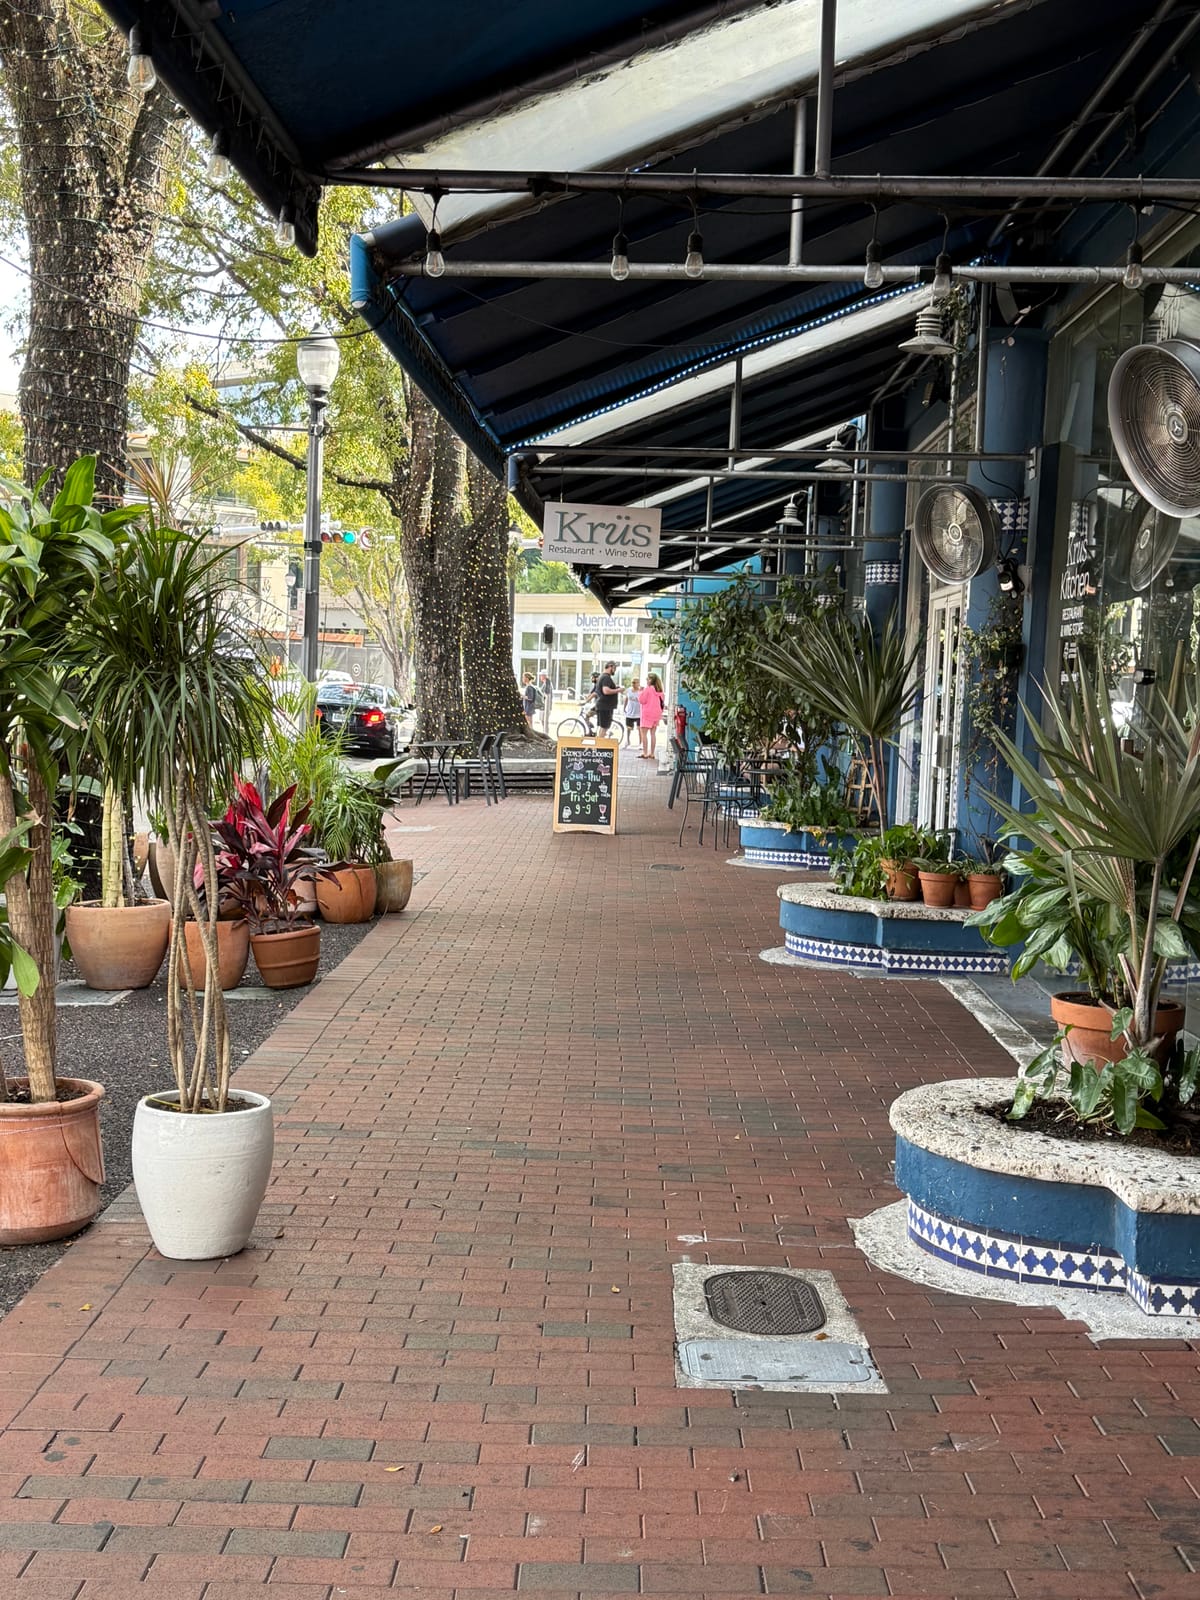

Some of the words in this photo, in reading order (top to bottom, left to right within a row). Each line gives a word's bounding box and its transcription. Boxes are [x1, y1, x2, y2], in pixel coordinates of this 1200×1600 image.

[553, 511, 652, 548] Krüs
[548, 544, 595, 556] Restaurant
[605, 548, 628, 558] Wine
[630, 549, 653, 559] Store
[1060, 567, 1090, 600] Kitchen
